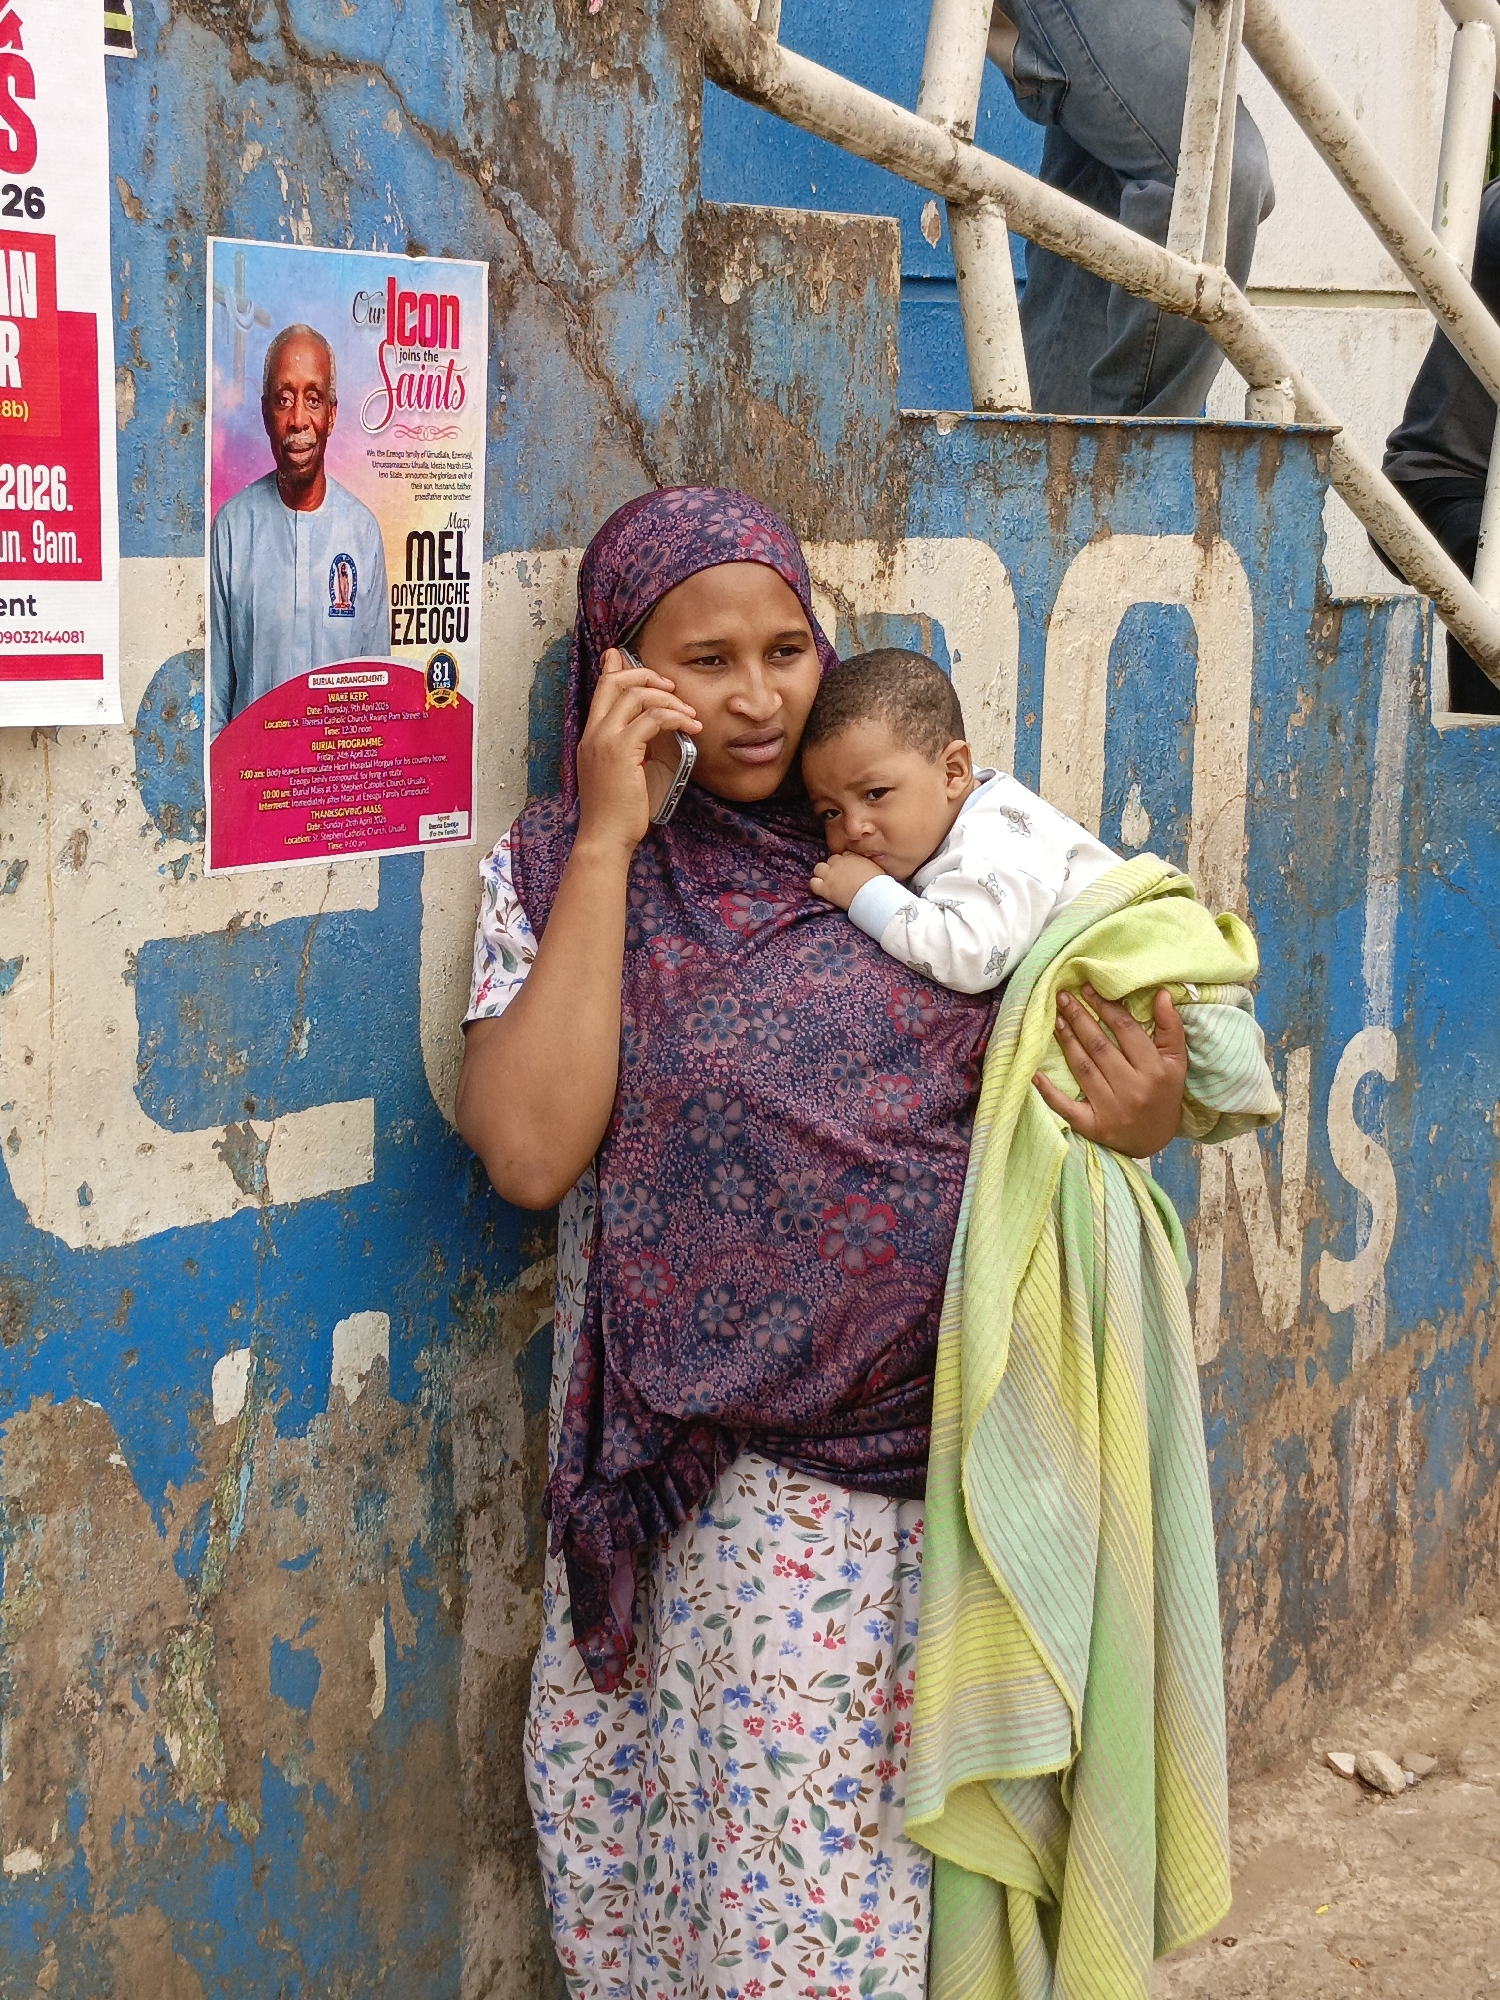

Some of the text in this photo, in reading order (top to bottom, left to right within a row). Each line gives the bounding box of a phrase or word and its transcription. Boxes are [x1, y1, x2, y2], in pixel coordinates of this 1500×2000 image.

[2, 184, 45, 219] 26
[353, 277, 460, 349] Our Icon
[399, 348, 438, 363] joins the
[362, 340, 467, 430] Saints
[421, 450, 426, 458] of
[0, 464, 73, 512] 2026.
[444, 512, 471, 534] Mazi
[33, 520, 82, 564] 9am.
[406, 531, 470, 581] MEL
[392, 583, 469, 607] ONYEMUCHE
[391, 607, 469, 646] EZEOGU
[433, 661, 450, 682] 81
[312, 674, 385, 686] BURIAL ARRANGEMENT:
[433, 681, 450, 689] YEARS
[328, 692, 348, 702] WAKE
[361, 703, 374, 712] April
[312, 737, 383, 750] BURIAL PROGRAMME:
[350, 750, 363, 760] April
[266, 768, 281, 778] Body
[350, 761, 372, 771] Hospital
[262, 790, 280, 799] 10:00
[292, 787, 310, 797] Burial
[311, 786, 324, 794] Mass
[292, 797, 326, 808] Immediately
[340, 794, 355, 802] Mass
[310, 804, 384, 820] THANKSGIVING MASS:
[359, 817, 372, 826] April
[284, 834, 311, 844] Location:
